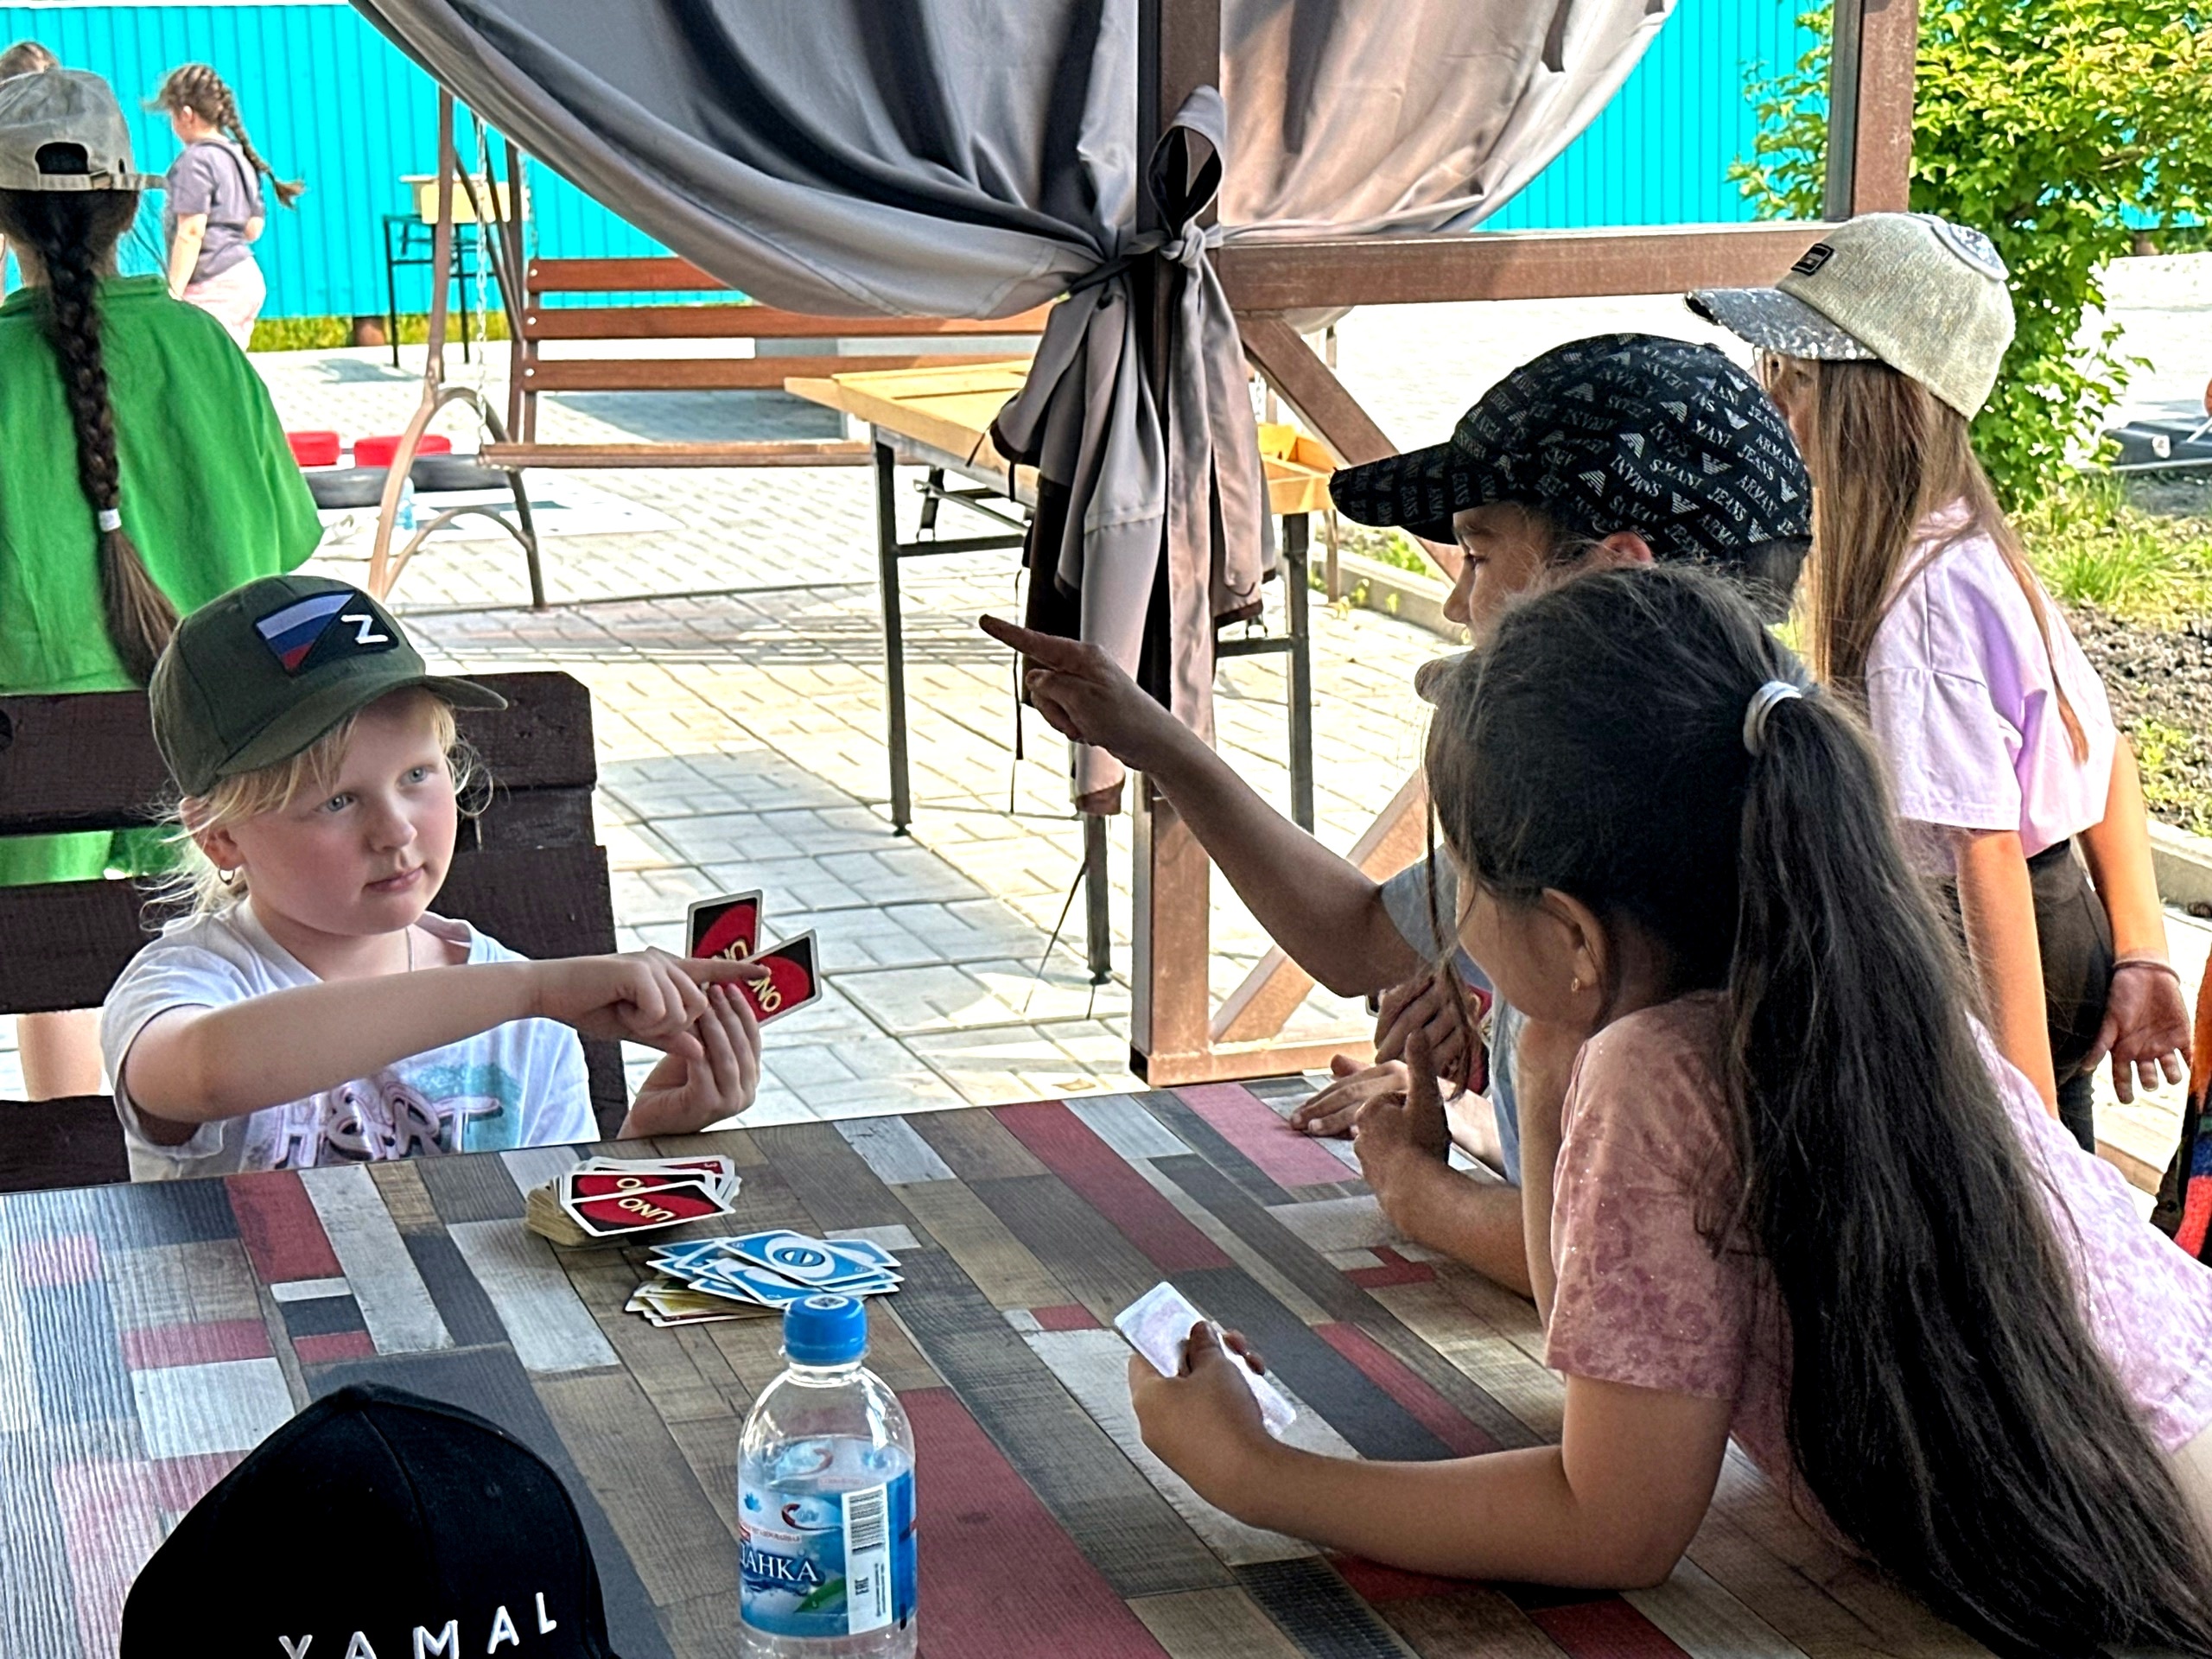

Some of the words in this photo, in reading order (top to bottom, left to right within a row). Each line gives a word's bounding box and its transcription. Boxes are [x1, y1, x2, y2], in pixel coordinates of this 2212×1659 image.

[340, 614, 389, 645] Z
[618, 1198, 677, 1222] UNO
[278, 1592, 557, 1659] YAMAL
